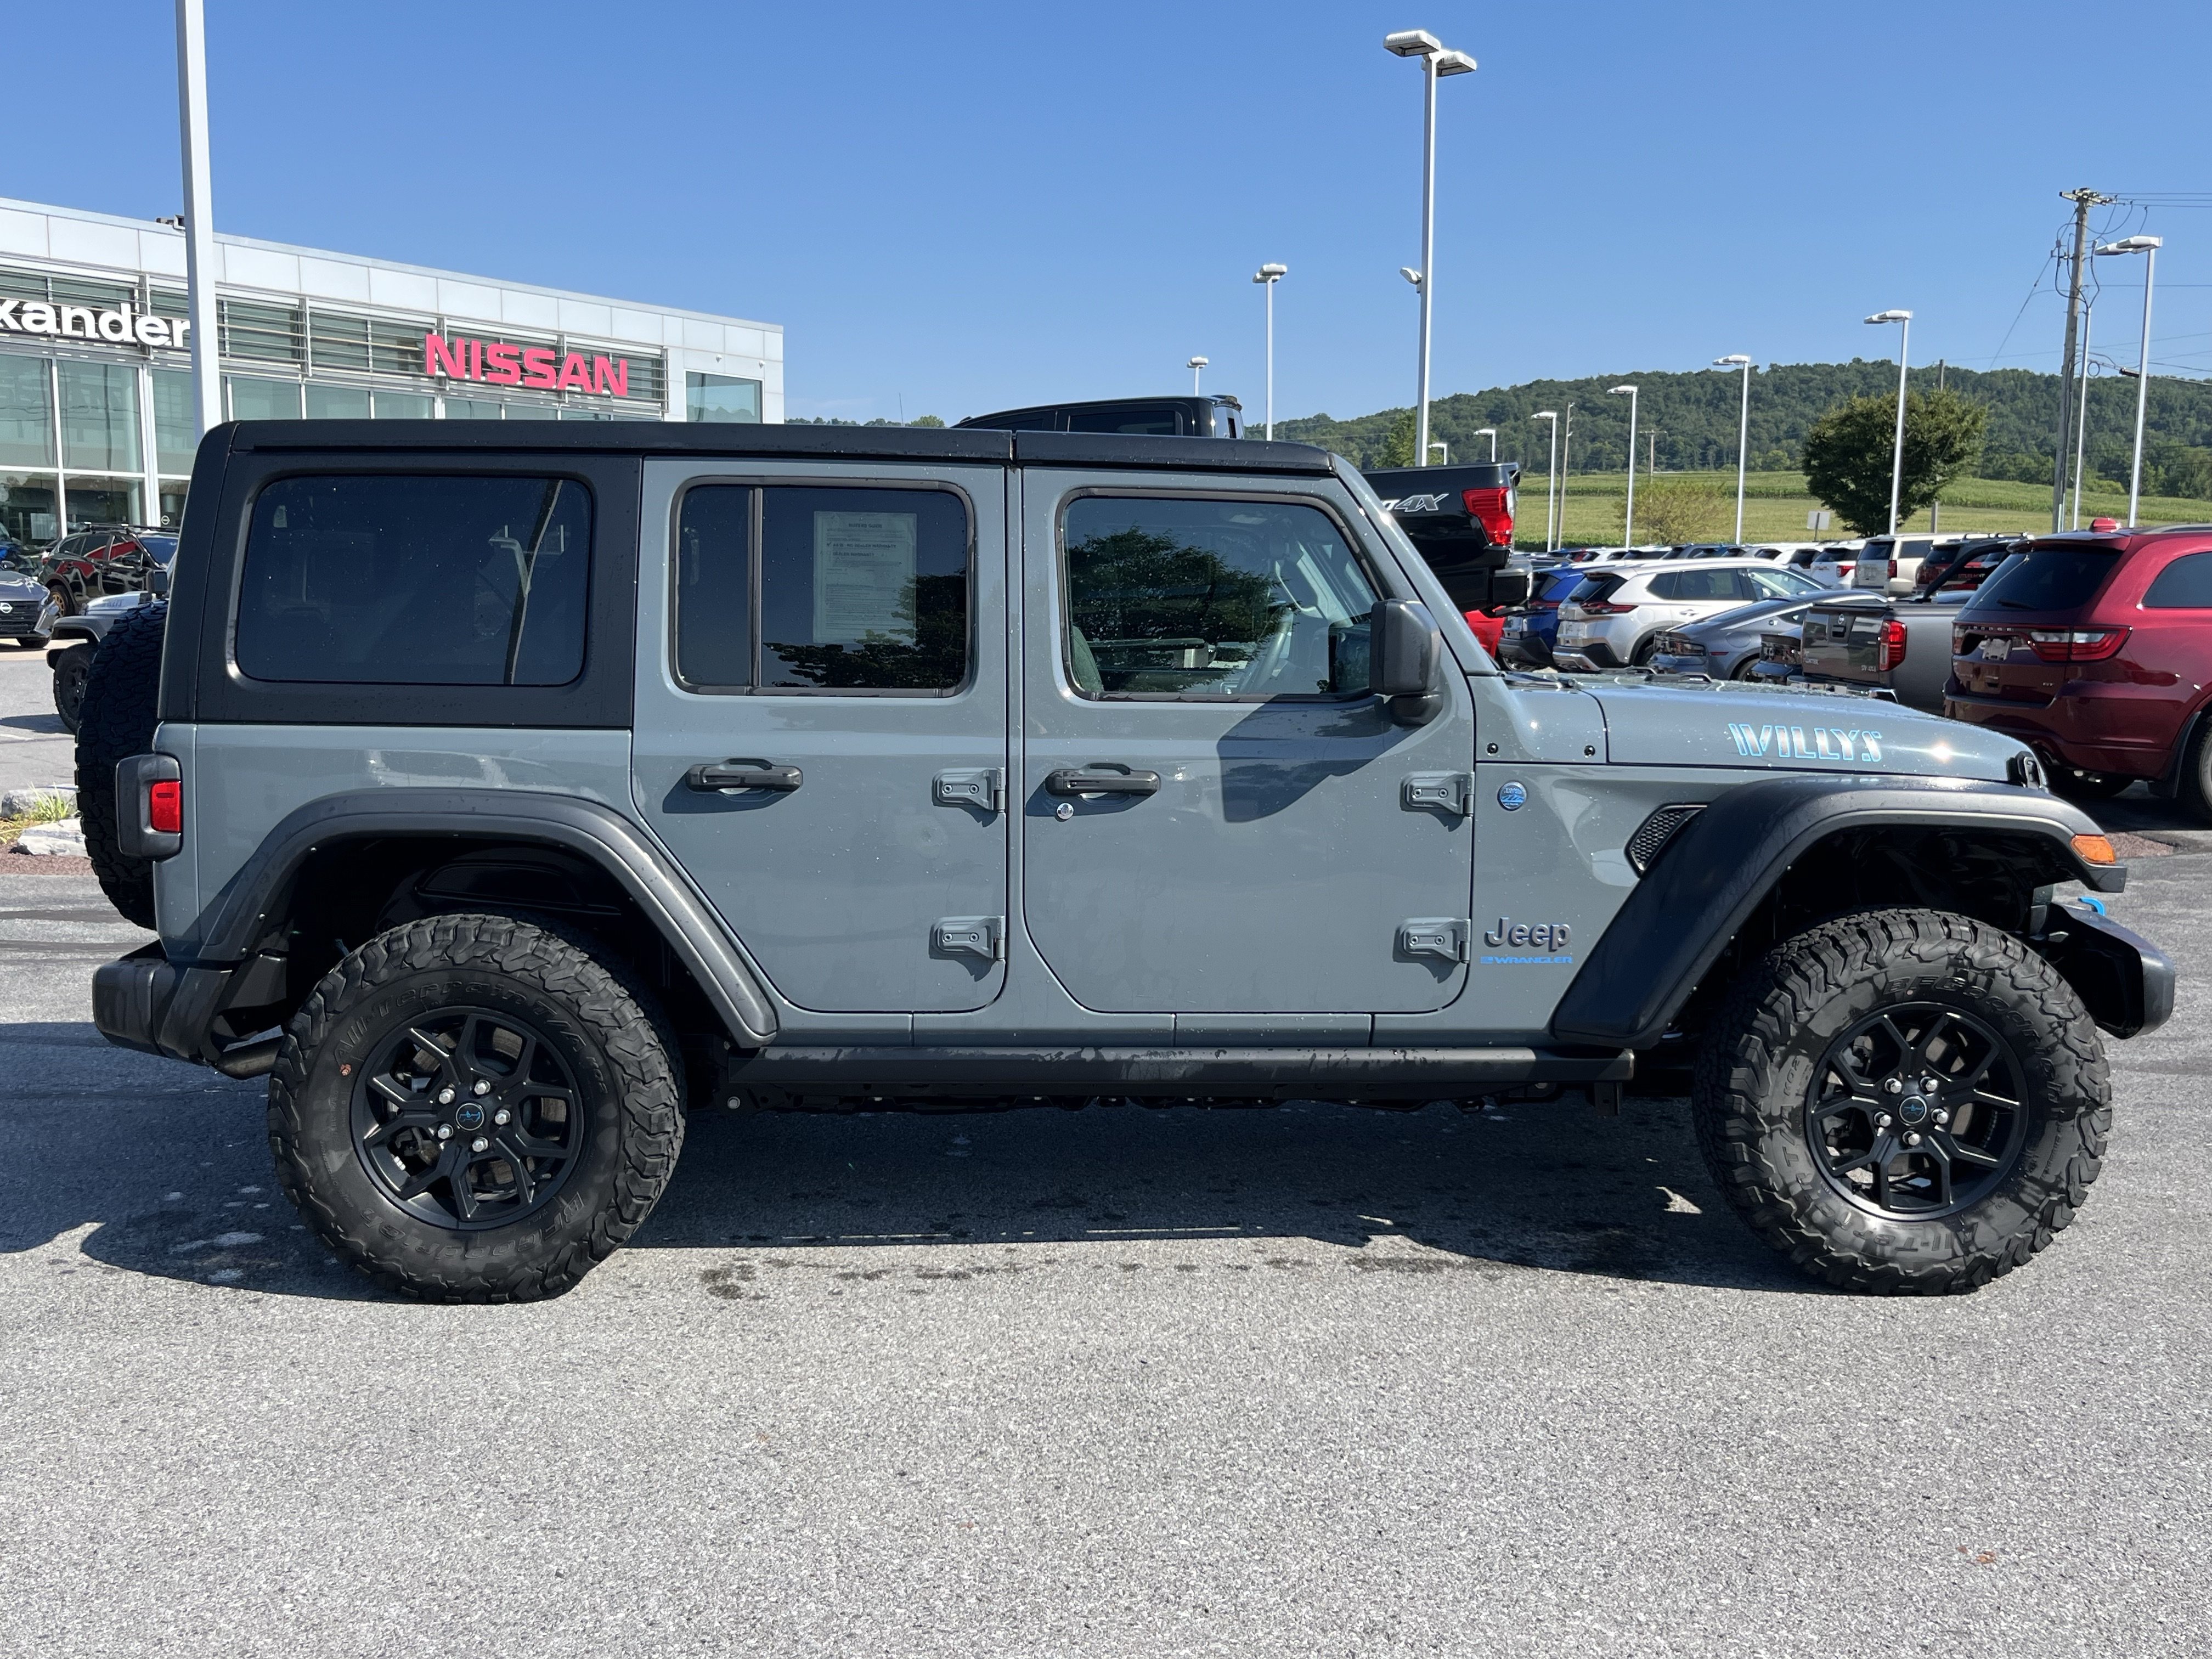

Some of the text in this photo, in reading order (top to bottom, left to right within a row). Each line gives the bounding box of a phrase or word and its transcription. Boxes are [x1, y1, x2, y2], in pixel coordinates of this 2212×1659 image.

[425, 334, 628, 396] NISSAN
[1728, 723, 1882, 762] WILLYS
[1485, 917, 1571, 951] Jeep
